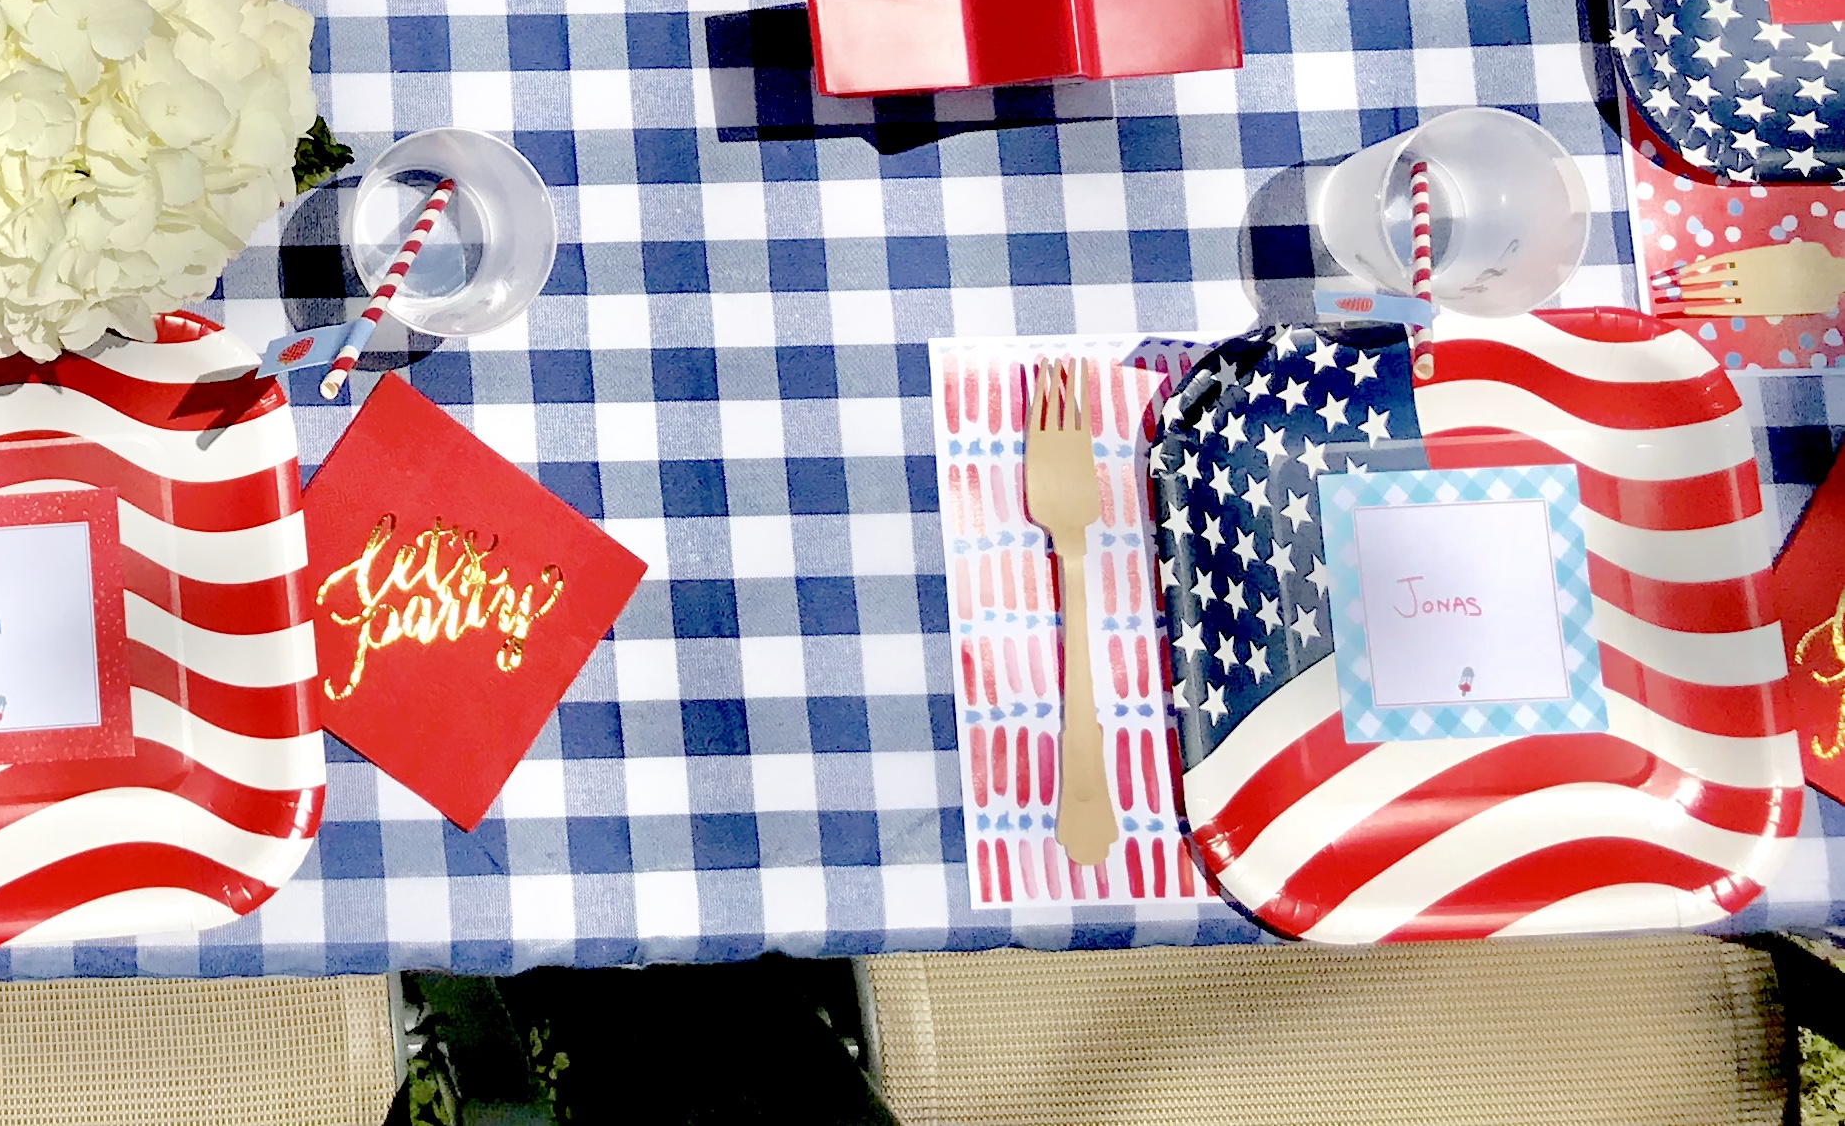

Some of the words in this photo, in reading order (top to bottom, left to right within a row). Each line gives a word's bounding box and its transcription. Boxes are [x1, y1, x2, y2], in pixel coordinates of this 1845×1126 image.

[315, 512, 499, 608] let's
[1392, 575, 1483, 619] JONAS
[324, 564, 564, 702] party
